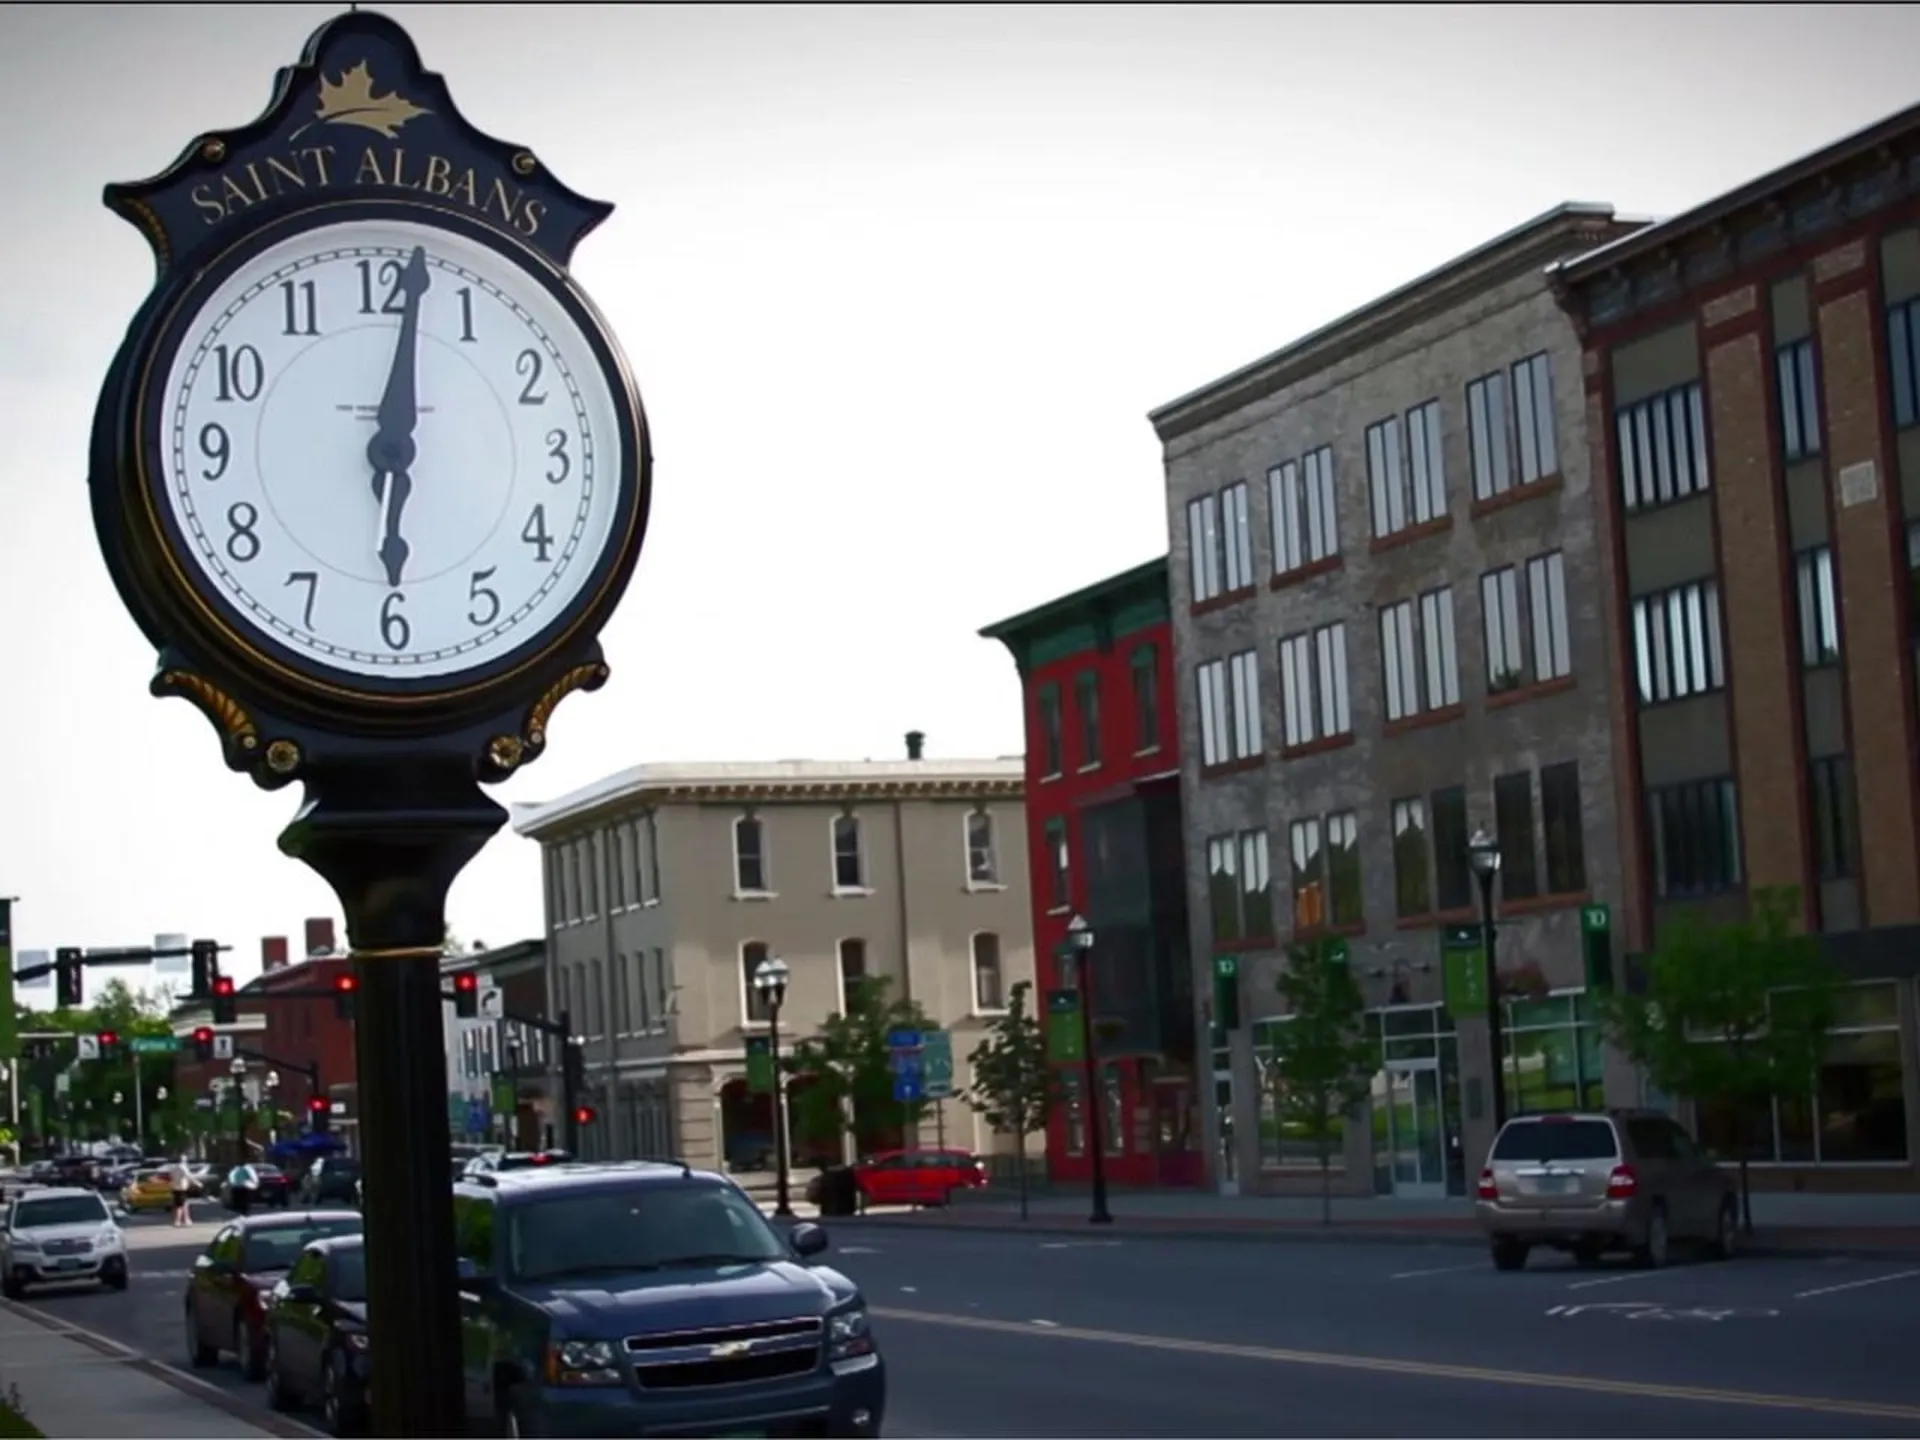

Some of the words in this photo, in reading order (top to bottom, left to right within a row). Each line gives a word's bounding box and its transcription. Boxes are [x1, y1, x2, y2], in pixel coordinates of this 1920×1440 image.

[190, 146, 336, 225] SAINT
[355, 146, 548, 238] ALBANS
[280, 280, 322, 336] 11
[357, 259, 406, 315] 12
[456, 287, 478, 342] 1
[214, 344, 265, 402] 10
[515, 348, 548, 405] 2
[200, 422, 231, 480] 9
[545, 428, 571, 484] 3
[226, 502, 261, 562] 8
[521, 503, 554, 562] 4
[284, 571, 318, 632] 7
[380, 592, 411, 650] 6
[467, 565, 501, 626] 5
